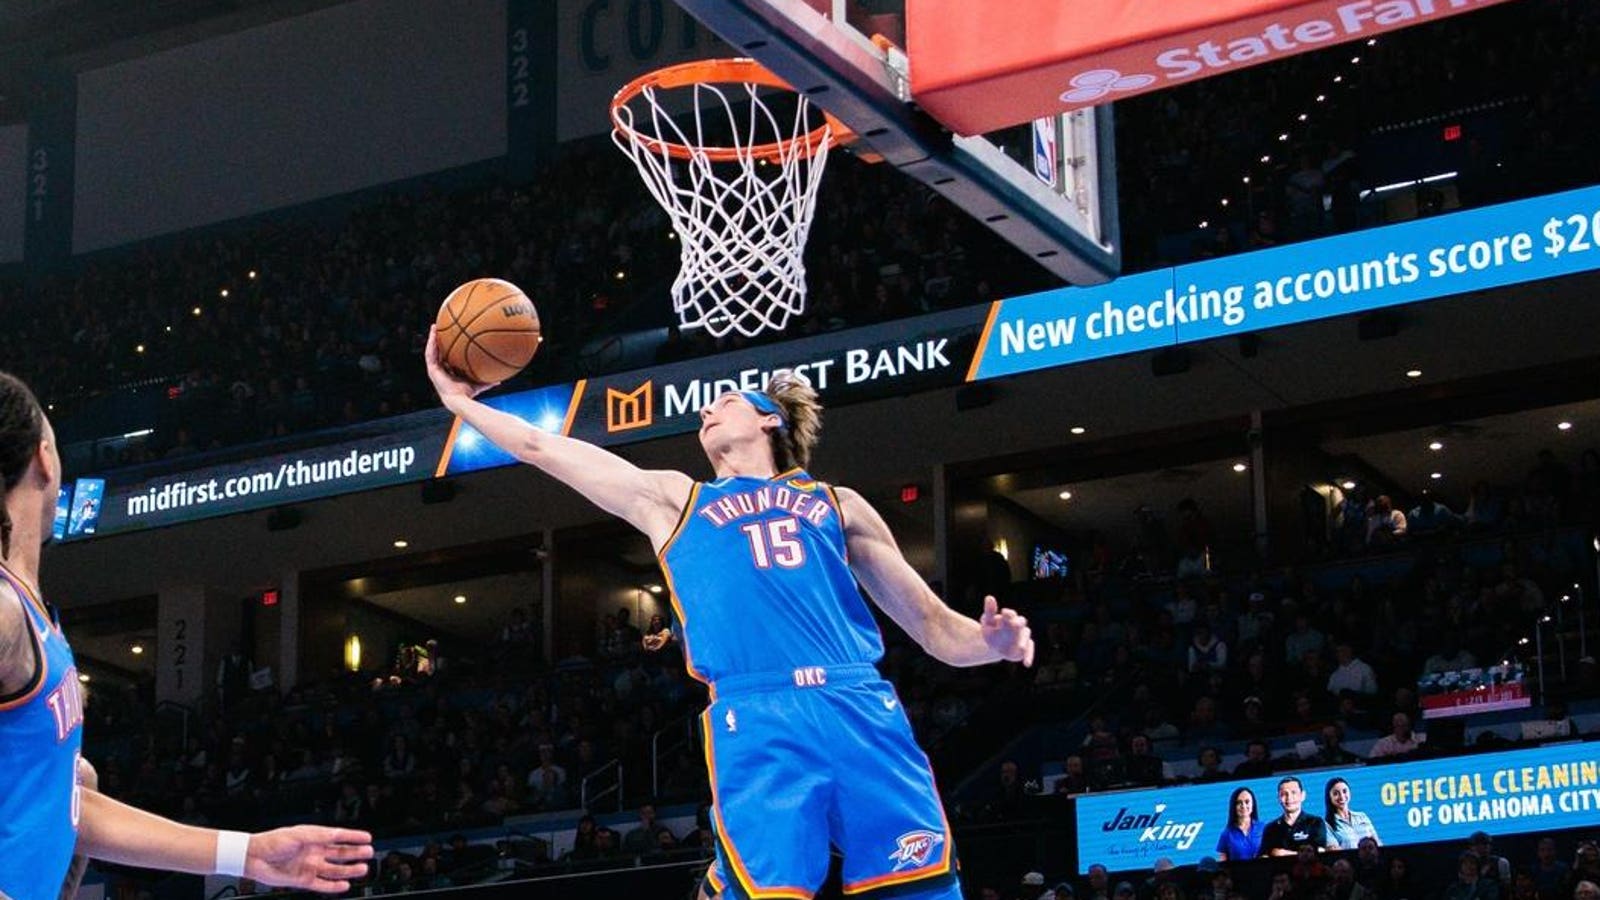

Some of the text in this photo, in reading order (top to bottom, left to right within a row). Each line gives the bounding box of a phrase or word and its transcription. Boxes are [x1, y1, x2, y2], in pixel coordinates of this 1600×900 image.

[511, 28, 530, 106] 322
[32, 149, 48, 221] 321
[1000, 315, 1077, 356] New
[1086, 284, 1246, 341] checking
[1253, 251, 1420, 310] accounts
[1429, 232, 1533, 278] score
[846, 337, 950, 384] BANK
[126, 445, 415, 516] midfirst.com/thunderup
[698, 486, 831, 527] THUNDER
[740, 516, 806, 569] 15
[174, 619, 186, 690] 221
[794, 667, 827, 687] OKC
[1380, 761, 1600, 806] OFFICIAL CLEANIN
[1407, 788, 1600, 828] OF OKLAHOMA CITY
[1102, 804, 1167, 832] Jani
